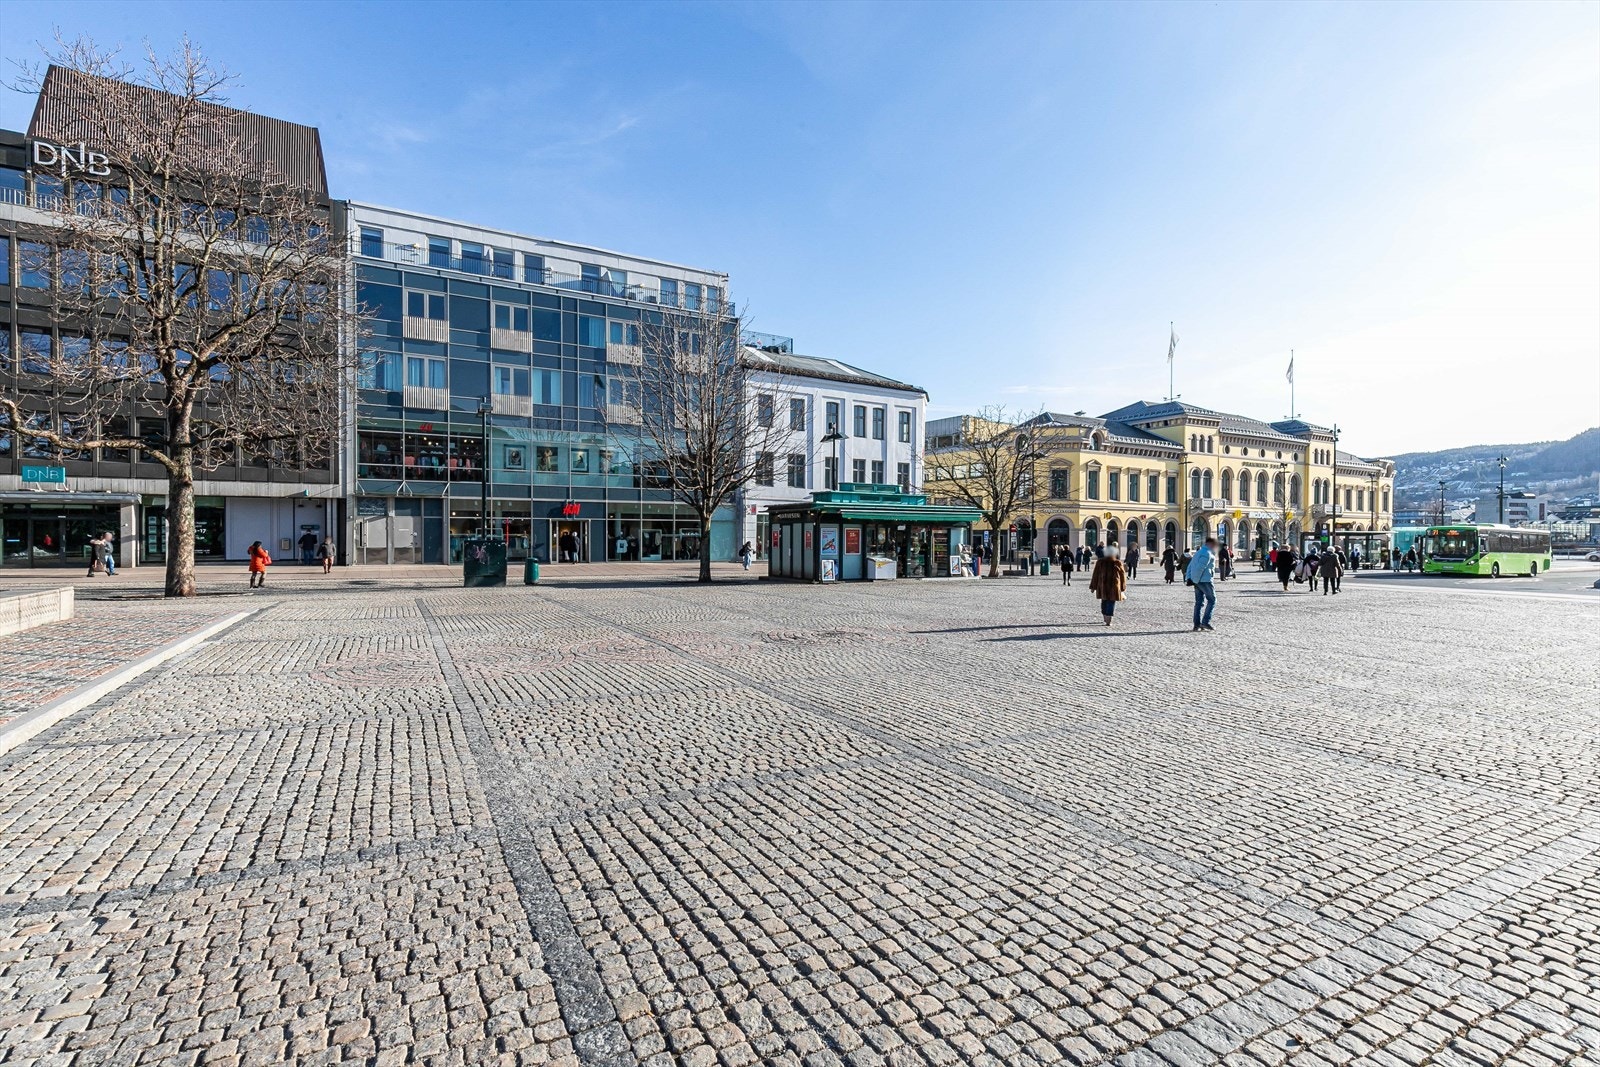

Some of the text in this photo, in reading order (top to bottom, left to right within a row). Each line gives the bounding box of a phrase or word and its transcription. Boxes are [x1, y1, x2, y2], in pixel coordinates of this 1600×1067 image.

[33, 141, 111, 178] DNB
[27, 466, 60, 482] DNB
[563, 503, 580, 516] H&M
